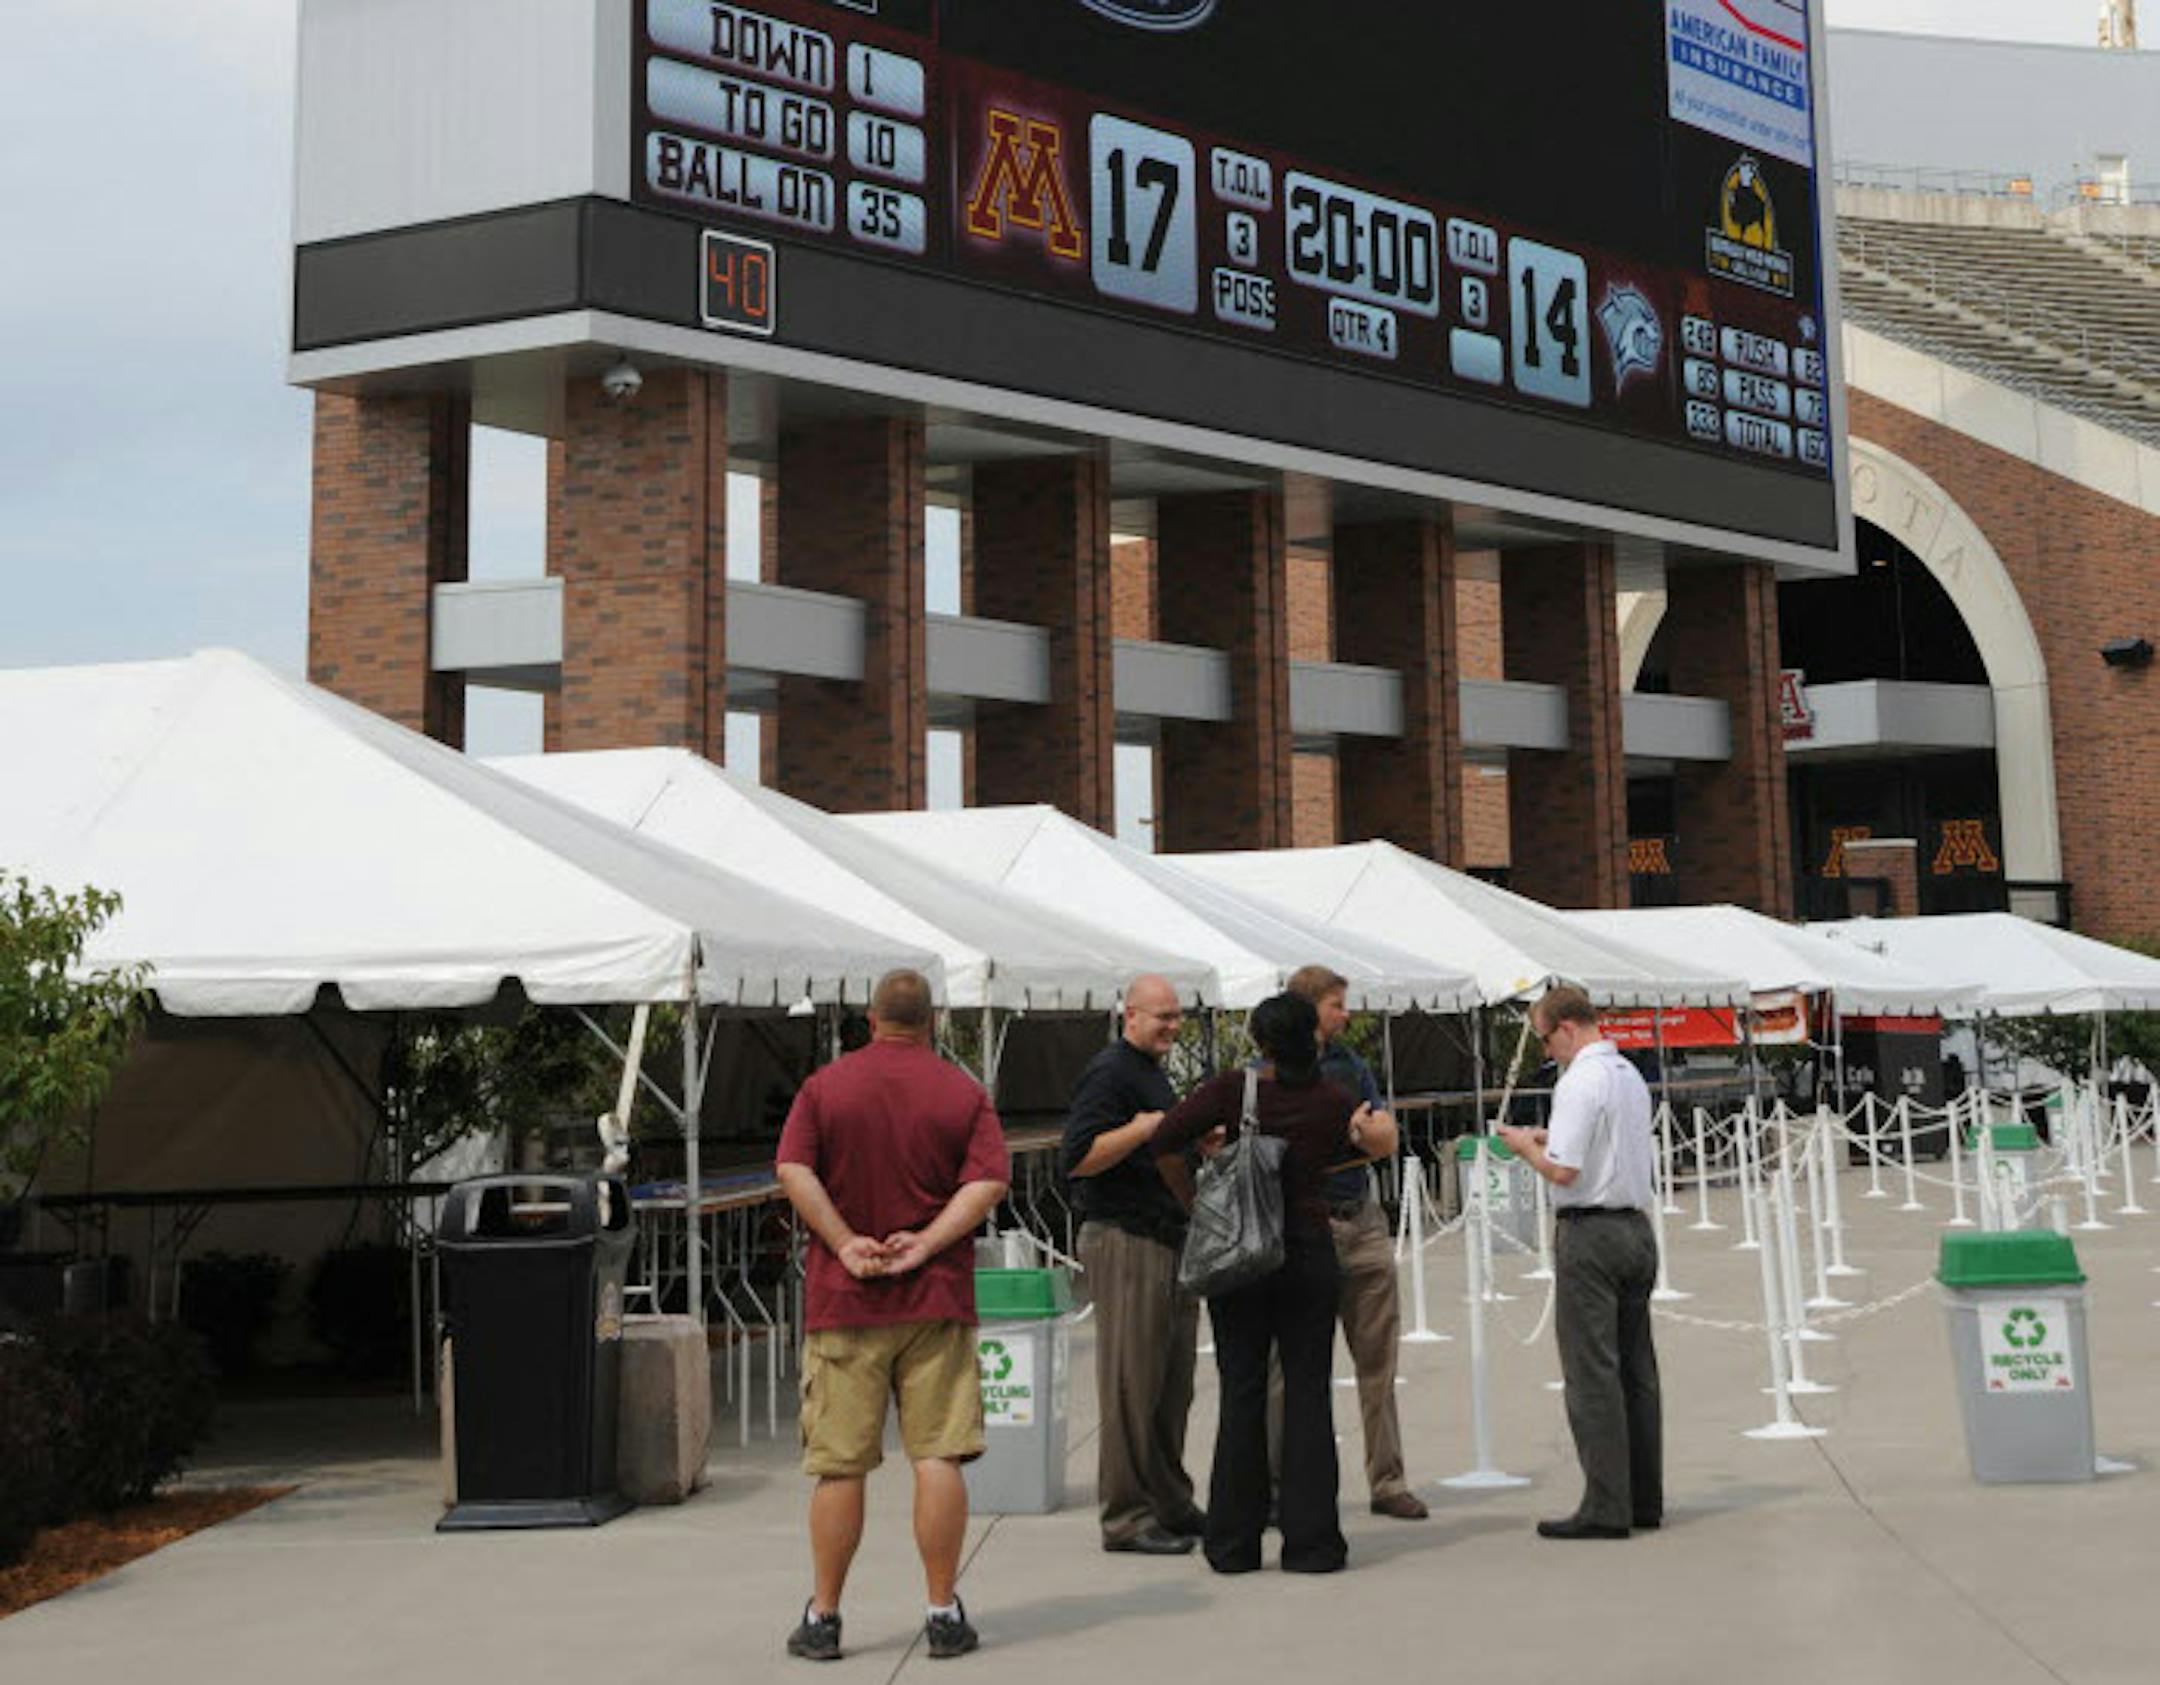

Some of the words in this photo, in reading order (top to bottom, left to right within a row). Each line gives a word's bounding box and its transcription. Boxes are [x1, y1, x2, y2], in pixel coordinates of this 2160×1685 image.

[710, 6, 828, 89] DOWN
[1671, 8, 1747, 60] AMERICAN
[1753, 41, 1803, 80] FAMILY
[863, 52, 874, 96] 1
[1678, 43, 1797, 103] INSURANCE
[719, 80, 766, 139] TO
[781, 98, 828, 155] GO
[865, 120, 896, 170] 10
[657, 136, 763, 210] BALL
[861, 188, 900, 240] 35
[1108, 147, 1179, 274] 17
[1236, 220, 1251, 257] 3
[1289, 185, 1433, 304] 20:00
[710, 249, 767, 318] 40
[1217, 270, 1277, 319] POSS
[1468, 285, 1481, 318] 3
[1332, 308, 1370, 345] QTR
[1376, 318, 1389, 352] 4
[1521, 266, 1580, 378] 14
[1735, 332, 1777, 370] RUSH
[1739, 375, 1777, 411] PASS
[1737, 415, 1784, 455] TOTAL
[1991, 1352, 2065, 1368] RECYCLE
[2008, 1367, 2049, 1381] ONLY
